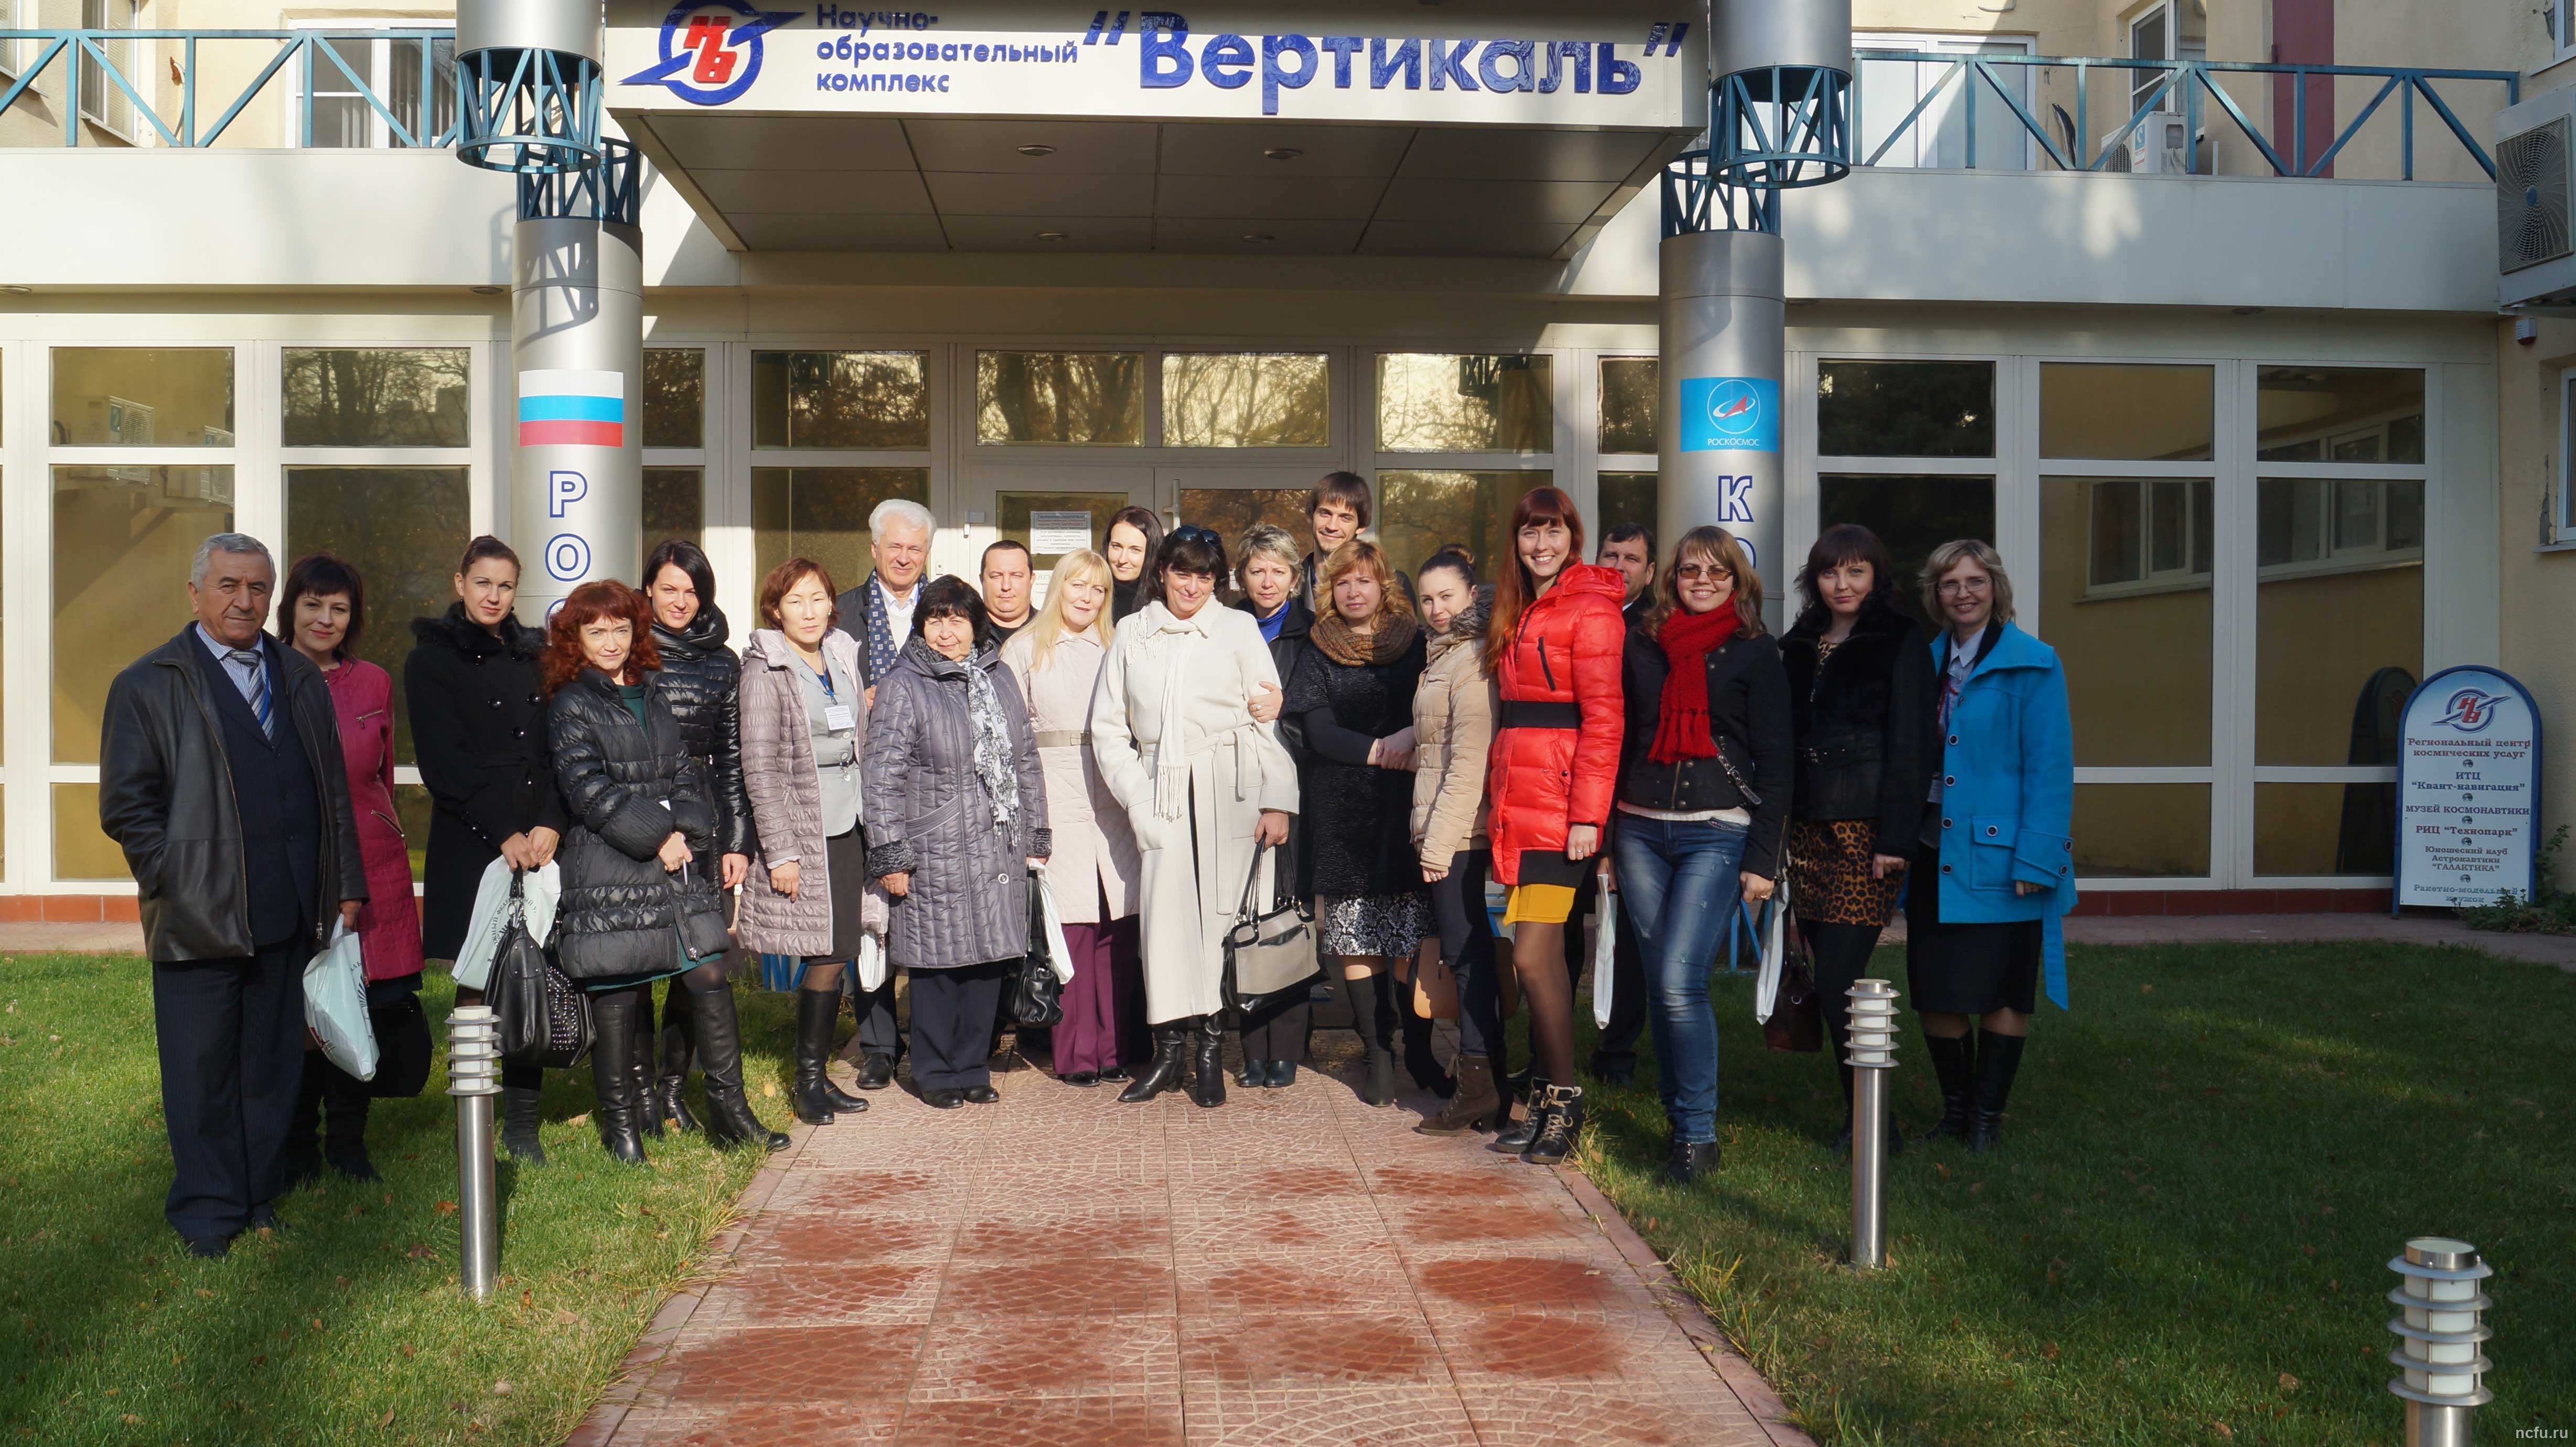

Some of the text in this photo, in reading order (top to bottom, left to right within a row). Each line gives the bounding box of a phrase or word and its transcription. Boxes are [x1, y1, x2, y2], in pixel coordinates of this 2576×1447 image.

[817, 4, 938, 37] Научно-
[817, 34, 1078, 68] образовательный
[817, 73, 949, 92] комплекс
[2407, 738, 2531, 749] Региональный центр
[2493, 751, 2525, 759] услуг
[2455, 772, 2481, 781] ИТЦ
[2412, 781, 2525, 791] “Квант-навигация”
[2406, 804, 2530, 815] МУЗЕЙ КОСМОНАВТИКИ
[2416, 825, 2518, 837] РИЦ “Технопарк”
[2425, 846, 2508, 856] Юношеский клуб
[2432, 863, 2499, 872] “ГАЛАКТИКА”
